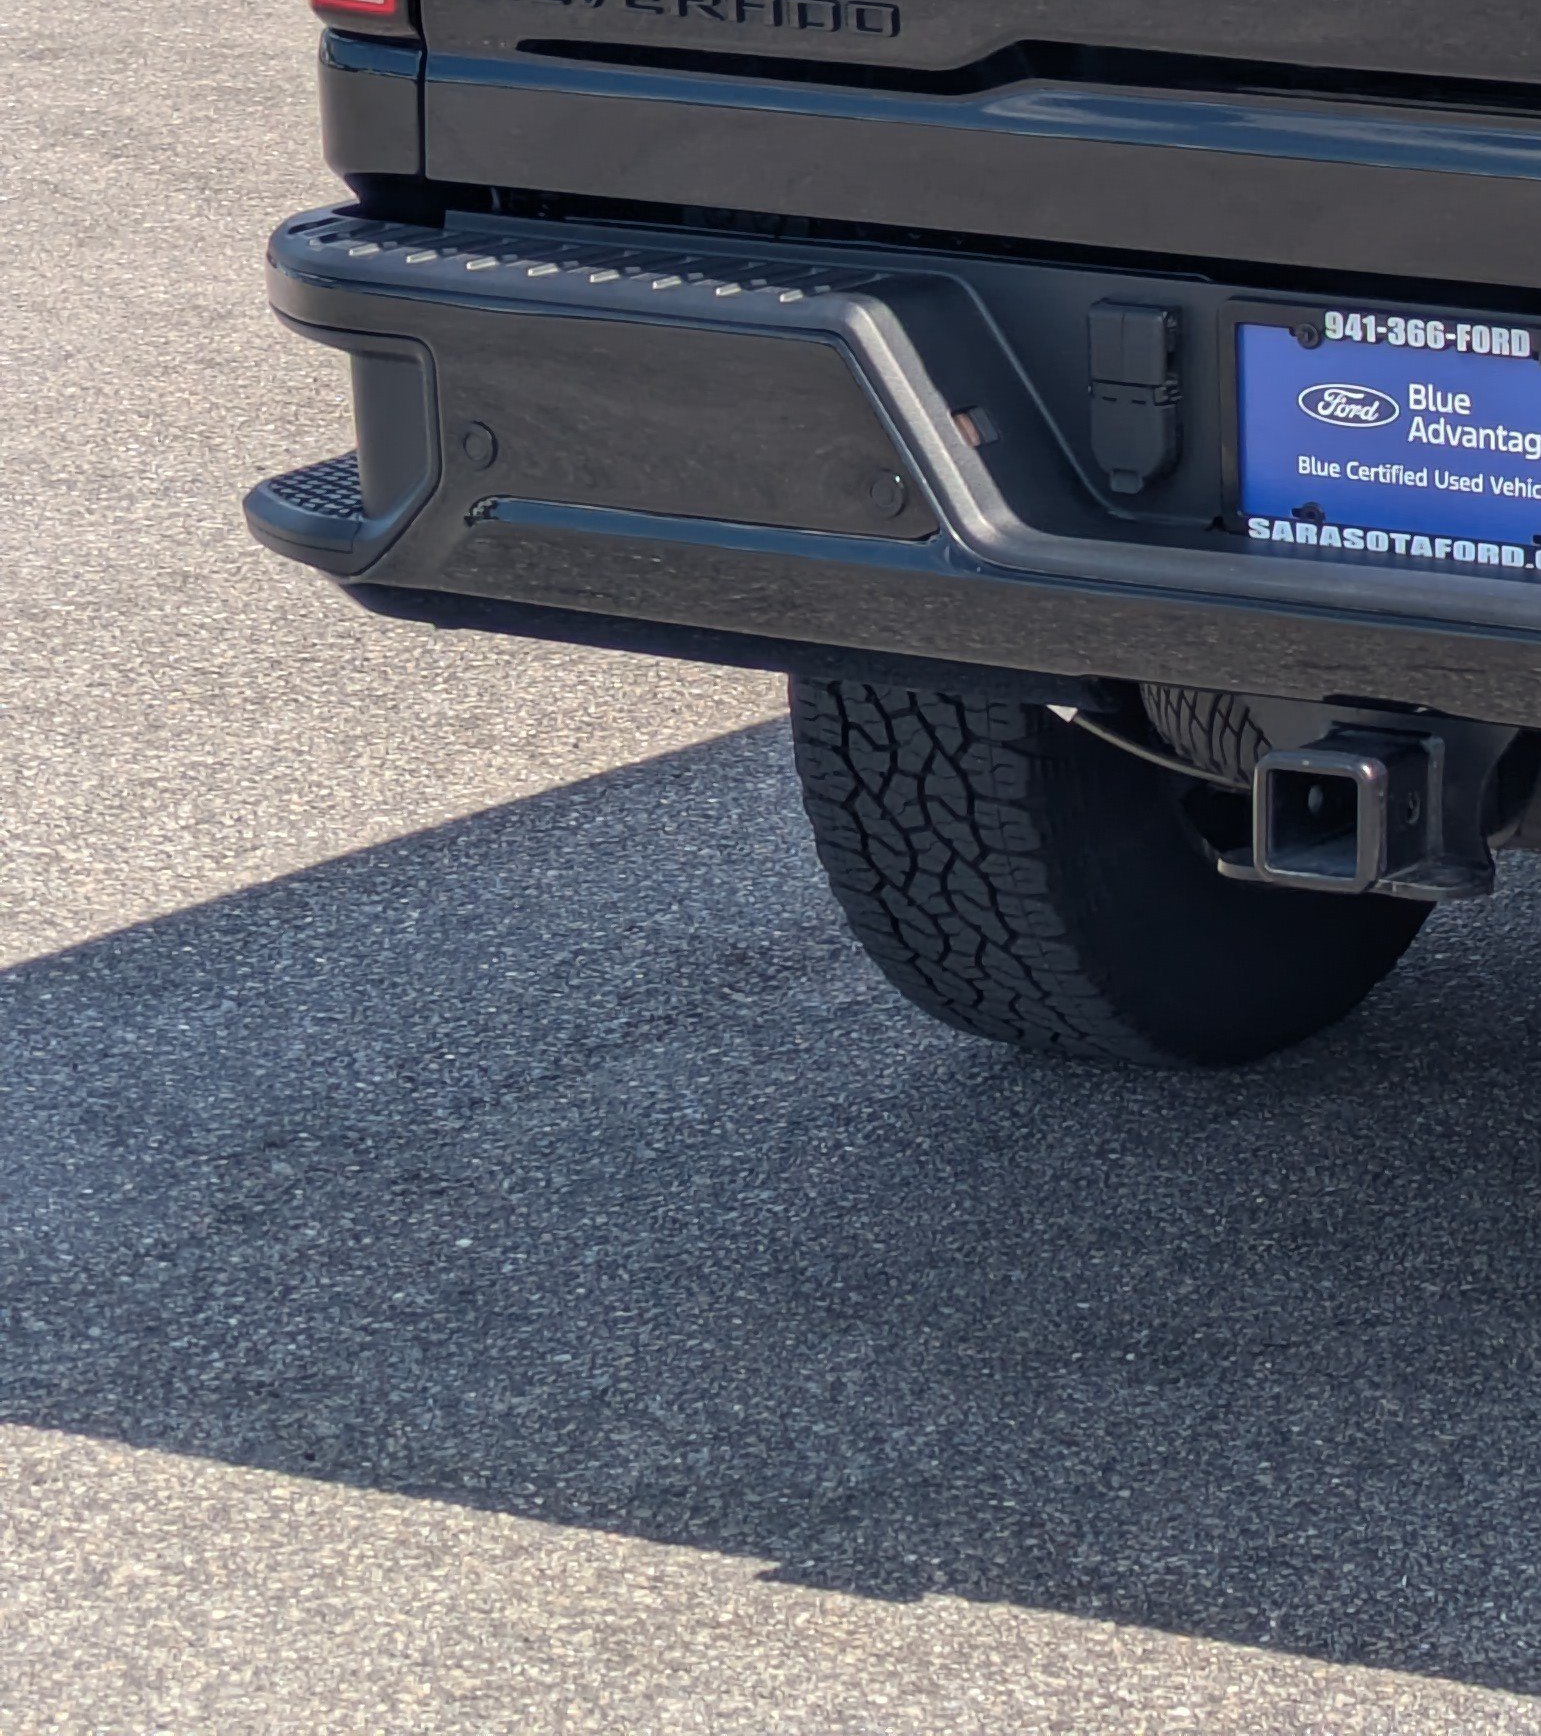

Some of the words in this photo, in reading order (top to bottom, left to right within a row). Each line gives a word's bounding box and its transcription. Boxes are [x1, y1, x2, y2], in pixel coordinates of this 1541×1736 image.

[1324, 310, 1531, 358] 941-366-FORD
[1317, 387, 1379, 423] Ford
[1408, 383, 1471, 415] Blue
[1298, 456, 1341, 479] Blue
[1346, 461, 1428, 487] Certified
[1434, 470, 1483, 494] Used
